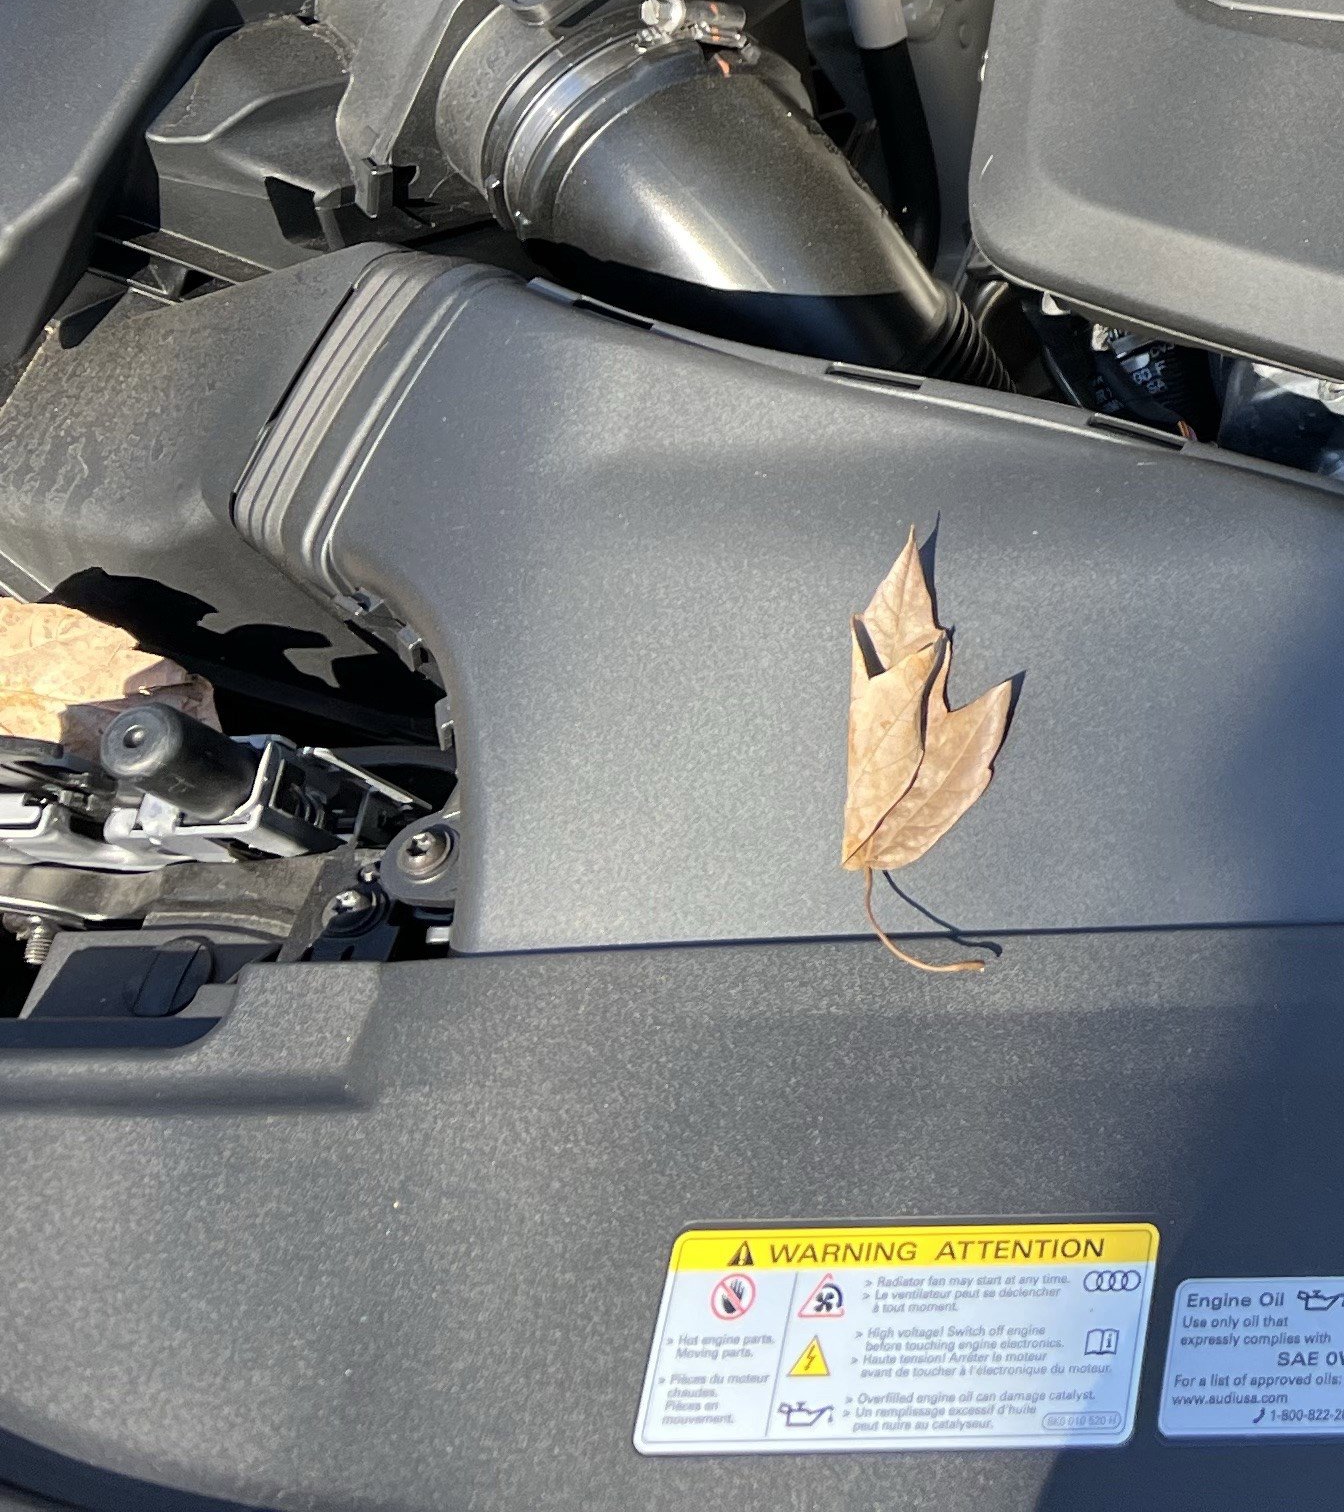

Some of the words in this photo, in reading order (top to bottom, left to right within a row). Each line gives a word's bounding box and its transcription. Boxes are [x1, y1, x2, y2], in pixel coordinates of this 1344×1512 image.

[770, 1241, 917, 1264] WARNING
[935, 1237, 1105, 1261] ATTENTION
[877, 1276, 925, 1288] Radiator
[928, 1275, 946, 1287] fan
[950, 1277, 973, 1289] may
[977, 1275, 1002, 1287] start
[1005, 1276, 1016, 1286] at
[1019, 1276, 1039, 1288] any
[1042, 1274, 1070, 1286] time.
[875, 1289, 888, 1300] Le
[891, 1289, 950, 1300] ventilateur
[954, 1289, 980, 1300] peut
[983, 1290, 996, 1299] se
[999, 1287, 1060, 1298] déclencher
[1187, 1292, 1252, 1311] Engine
[1259, 1291, 1285, 1307] Oil
[882, 1303, 905, 1313] tout
[908, 1302, 959, 1313] moment.
[1183, 1315, 1207, 1328] Use
[1211, 1315, 1240, 1330] only
[1243, 1315, 1259, 1327] oil
[1263, 1316, 1288, 1327] that
[679, 1334, 698, 1345] Hot
[701, 1334, 741, 1347] engine
[743, 1335, 775, 1346] parts.
[868, 1327, 894, 1341] High
[897, 1326, 944, 1340] voltage!
[948, 1326, 985, 1337] Switch
[989, 1325, 1004, 1336] off
[1007, 1326, 1045, 1338] engine
[1180, 1333, 1241, 1348] expressly
[1243, 1333, 1300, 1348] complies
[1304, 1332, 1331, 1344] with
[866, 1340, 900, 1352] before
[905, 1340, 955, 1353] touching
[958, 1340, 997, 1353] engine
[1000, 1338, 1065, 1350] electronics.
[676, 1348, 719, 1360] Moving
[722, 1349, 753, 1360] parts.
[863, 1354, 897, 1365] Haute
[900, 1354, 945, 1364] tension!
[992, 1352, 1001, 1362] le
[1005, 1352, 1047, 1362] moteur
[1277, 1351, 1319, 1367] SAE
[861, 1367, 892, 1378] avant
[896, 1367, 910, 1377] de
[913, 1366, 956, 1377] toucher
[1050, 1363, 1065, 1374] du
[1068, 1363, 1112, 1375] moteur.
[709, 1374, 724, 1384] du
[727, 1374, 770, 1384] moteur
[1174, 1374, 1196, 1387] For
[1210, 1374, 1230, 1386] list
[1233, 1373, 1248, 1386] of
[1250, 1373, 1311, 1388] approved
[857, 1392, 914, 1405] Overfilled
[917, 1393, 955, 1406] engine
[959, 1391, 972, 1402] oil
[976, 1392, 996, 1402] can
[1000, 1390, 1045, 1403] damage
[1049, 1390, 1095, 1402] catalyst.
[1172, 1391, 1288, 1405] www.audiusa.com
[704, 1402, 719, 1411] en
[856, 1408, 872, 1418] Un
[876, 1406, 945, 1419] remplissage
[950, 1405, 993, 1416] excessif
[853, 1420, 878, 1432] peut
[882, 1419, 911, 1430] nuire
[915, 1420, 929, 1430] au
[932, 1418, 993, 1431] catalyseur.
